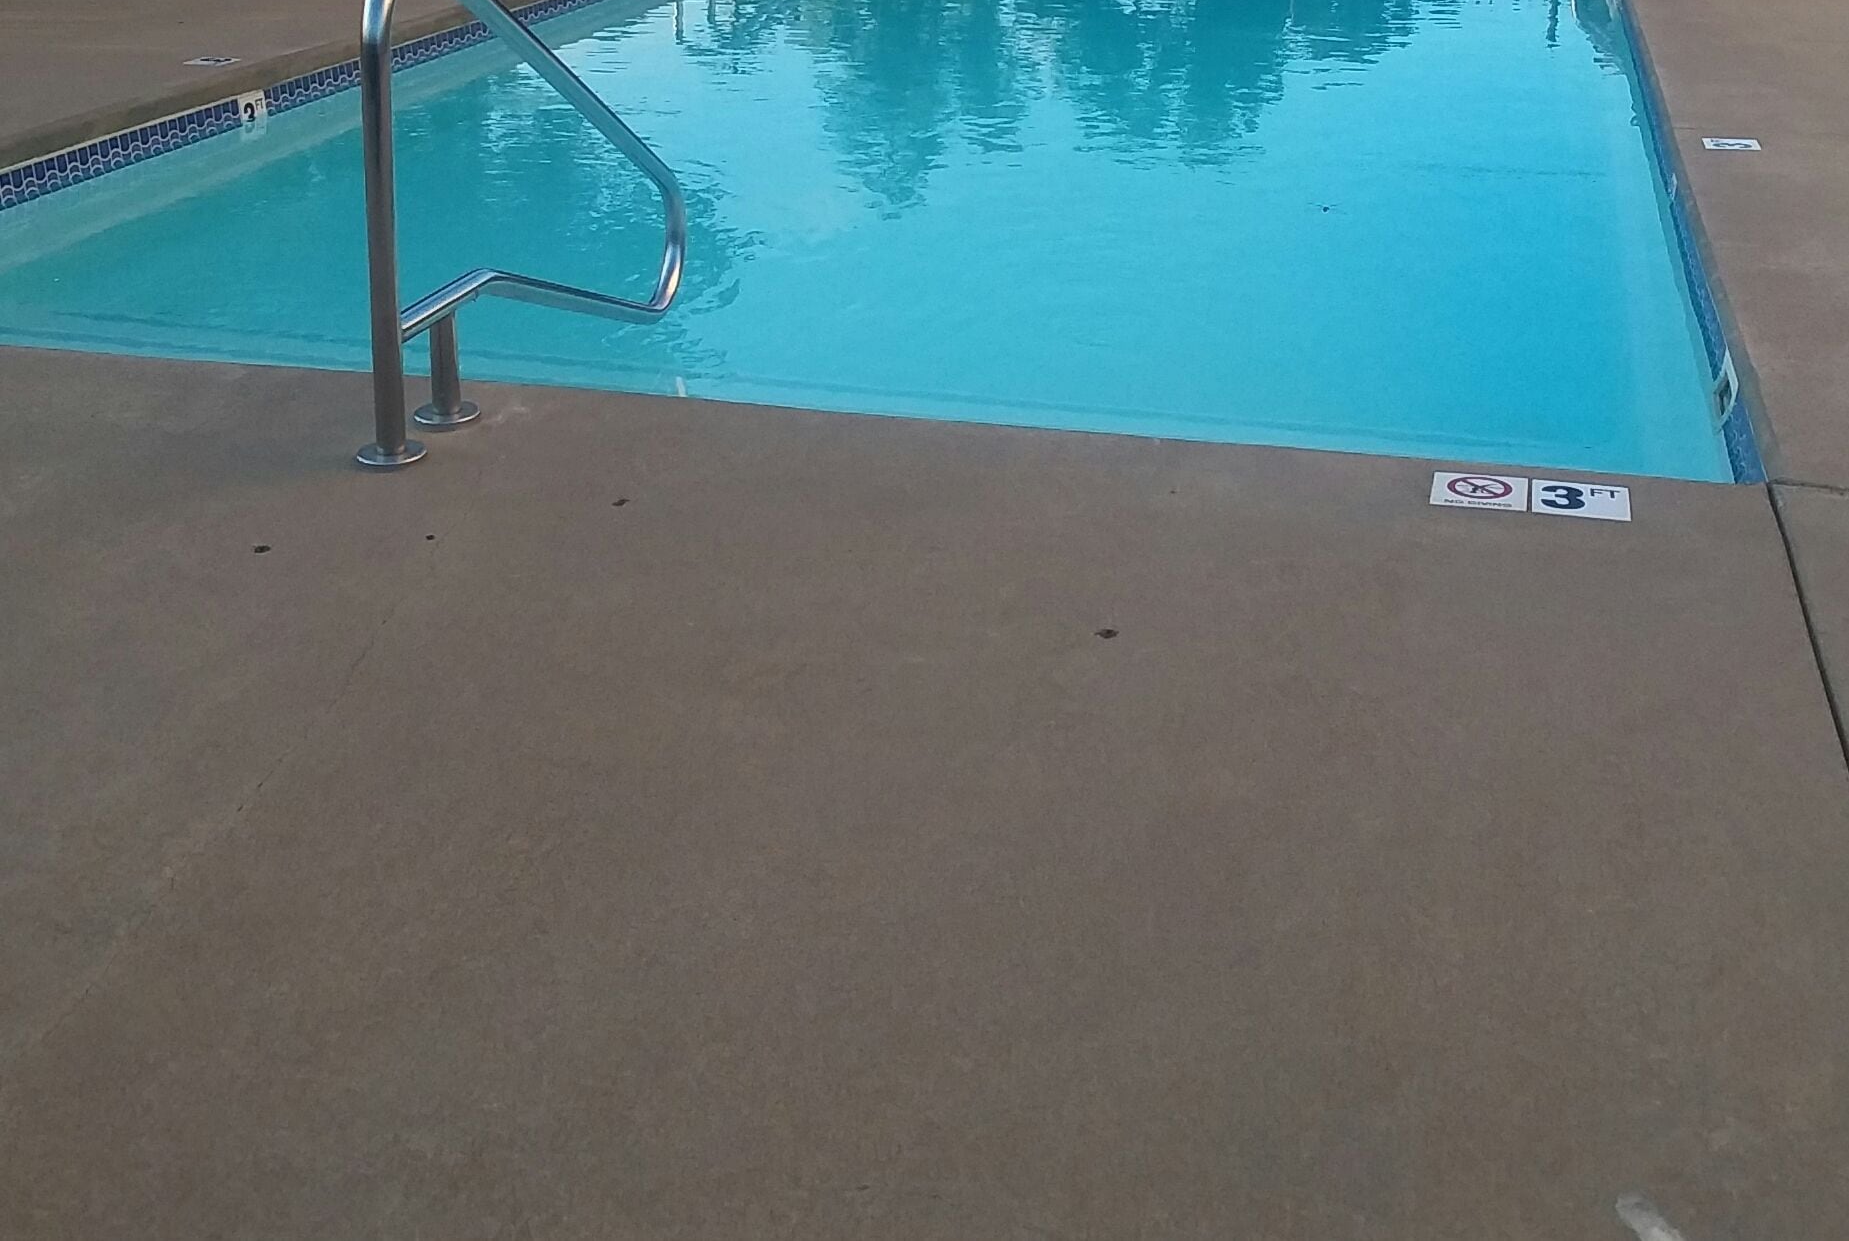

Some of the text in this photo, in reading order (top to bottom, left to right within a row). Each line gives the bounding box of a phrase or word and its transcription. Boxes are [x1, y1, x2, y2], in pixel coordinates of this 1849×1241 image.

[254, 97, 264, 110] FT
[1540, 484, 1621, 510] 3 FT
